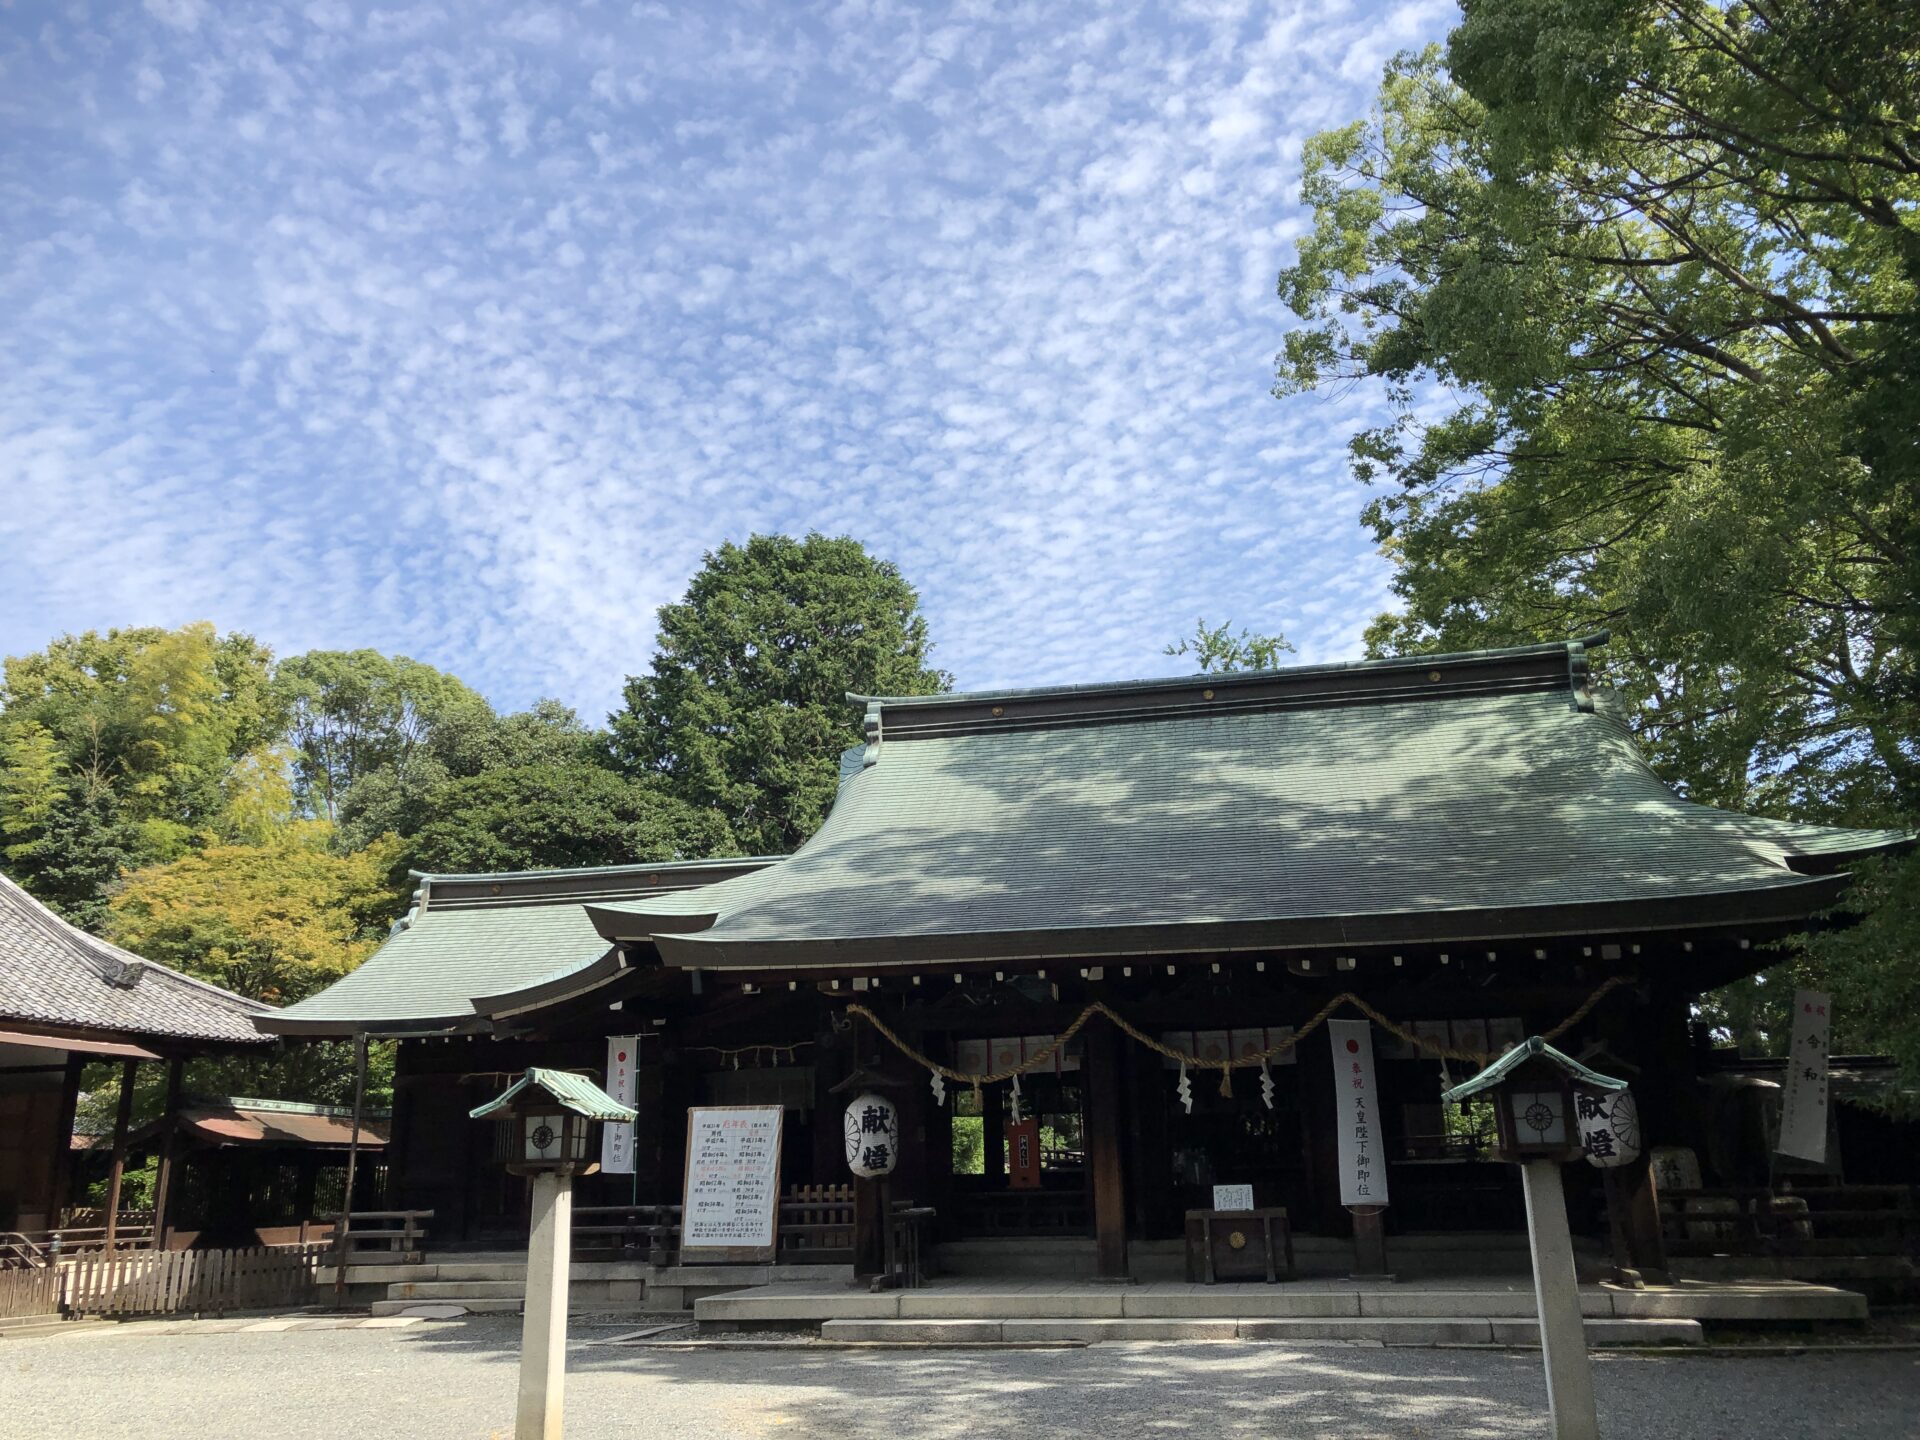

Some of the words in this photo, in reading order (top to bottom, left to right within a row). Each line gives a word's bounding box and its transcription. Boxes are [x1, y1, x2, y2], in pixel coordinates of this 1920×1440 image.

[1351, 1062, 1365, 1089] 奉祝
[1802, 1034, 1821, 1081] 令和
[613, 1092, 624, 1163] 天下御即位
[861, 1105, 891, 1170] 献燈
[1355, 1096, 1371, 1197] 天皇陛下御即位
